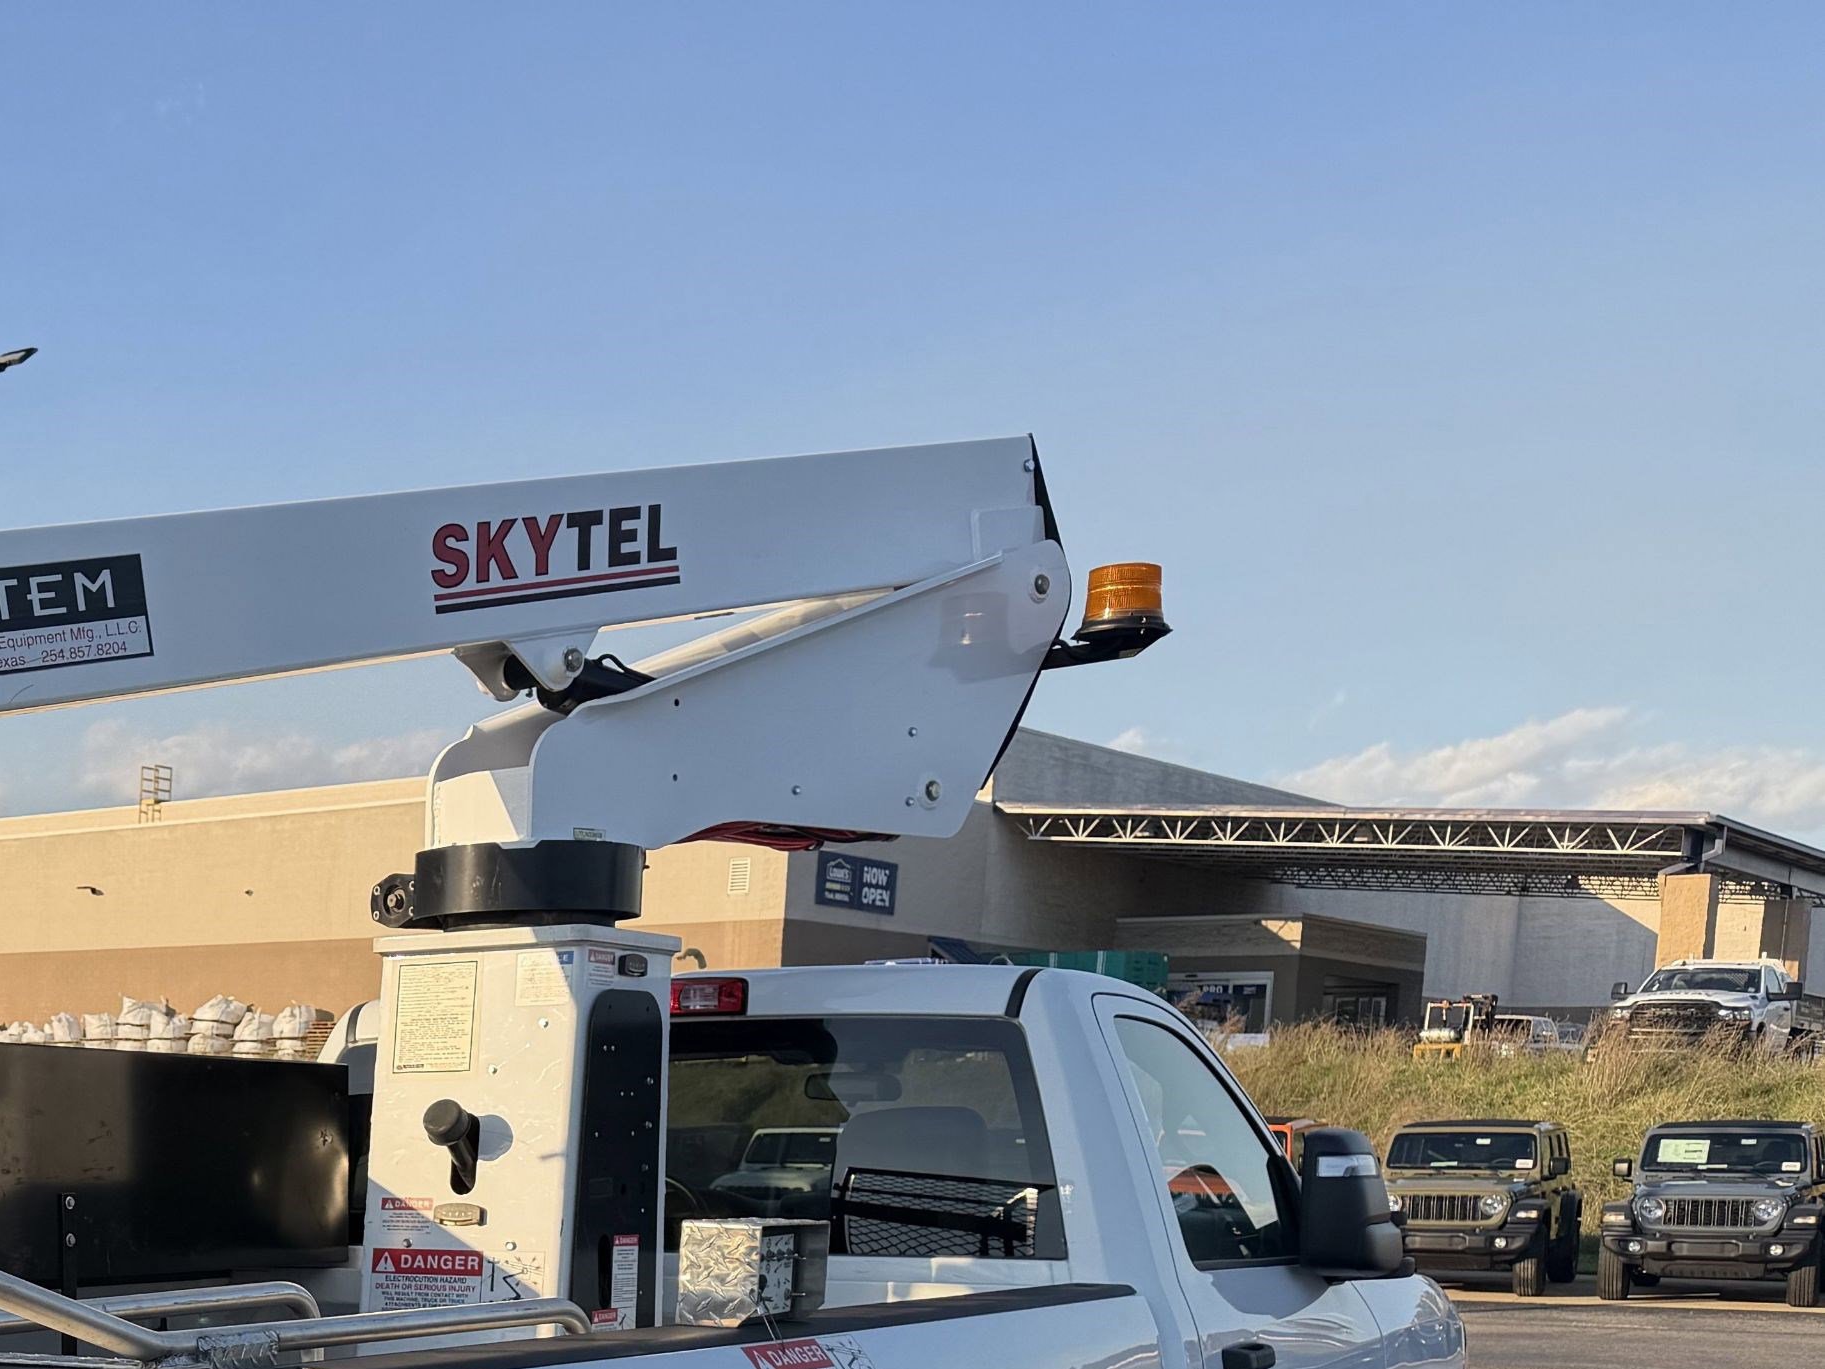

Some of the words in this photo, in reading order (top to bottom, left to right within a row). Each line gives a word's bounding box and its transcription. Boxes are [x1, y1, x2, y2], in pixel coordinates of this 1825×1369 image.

[430, 504, 678, 589] SKYTEL
[70, 627, 103, 643] Mfg.,
[105, 620, 143, 637] L.L.C.
[41, 640, 128, 663] 254.857.8204
[863, 866, 890, 887] NOW
[861, 886, 891, 907] OPEN
[401, 1254, 479, 1271] DANGER
[375, 1282, 400, 1290] DEATH
[401, 1283, 413, 1291] OR
[414, 1283, 447, 1292] SERIOUS
[448, 1285, 476, 1293] INJURY
[385, 1275, 439, 1284] ELECTROCUTION
[439, 1276, 467, 1284] HAZARD
[767, 1345, 828, 1367] DANGER
